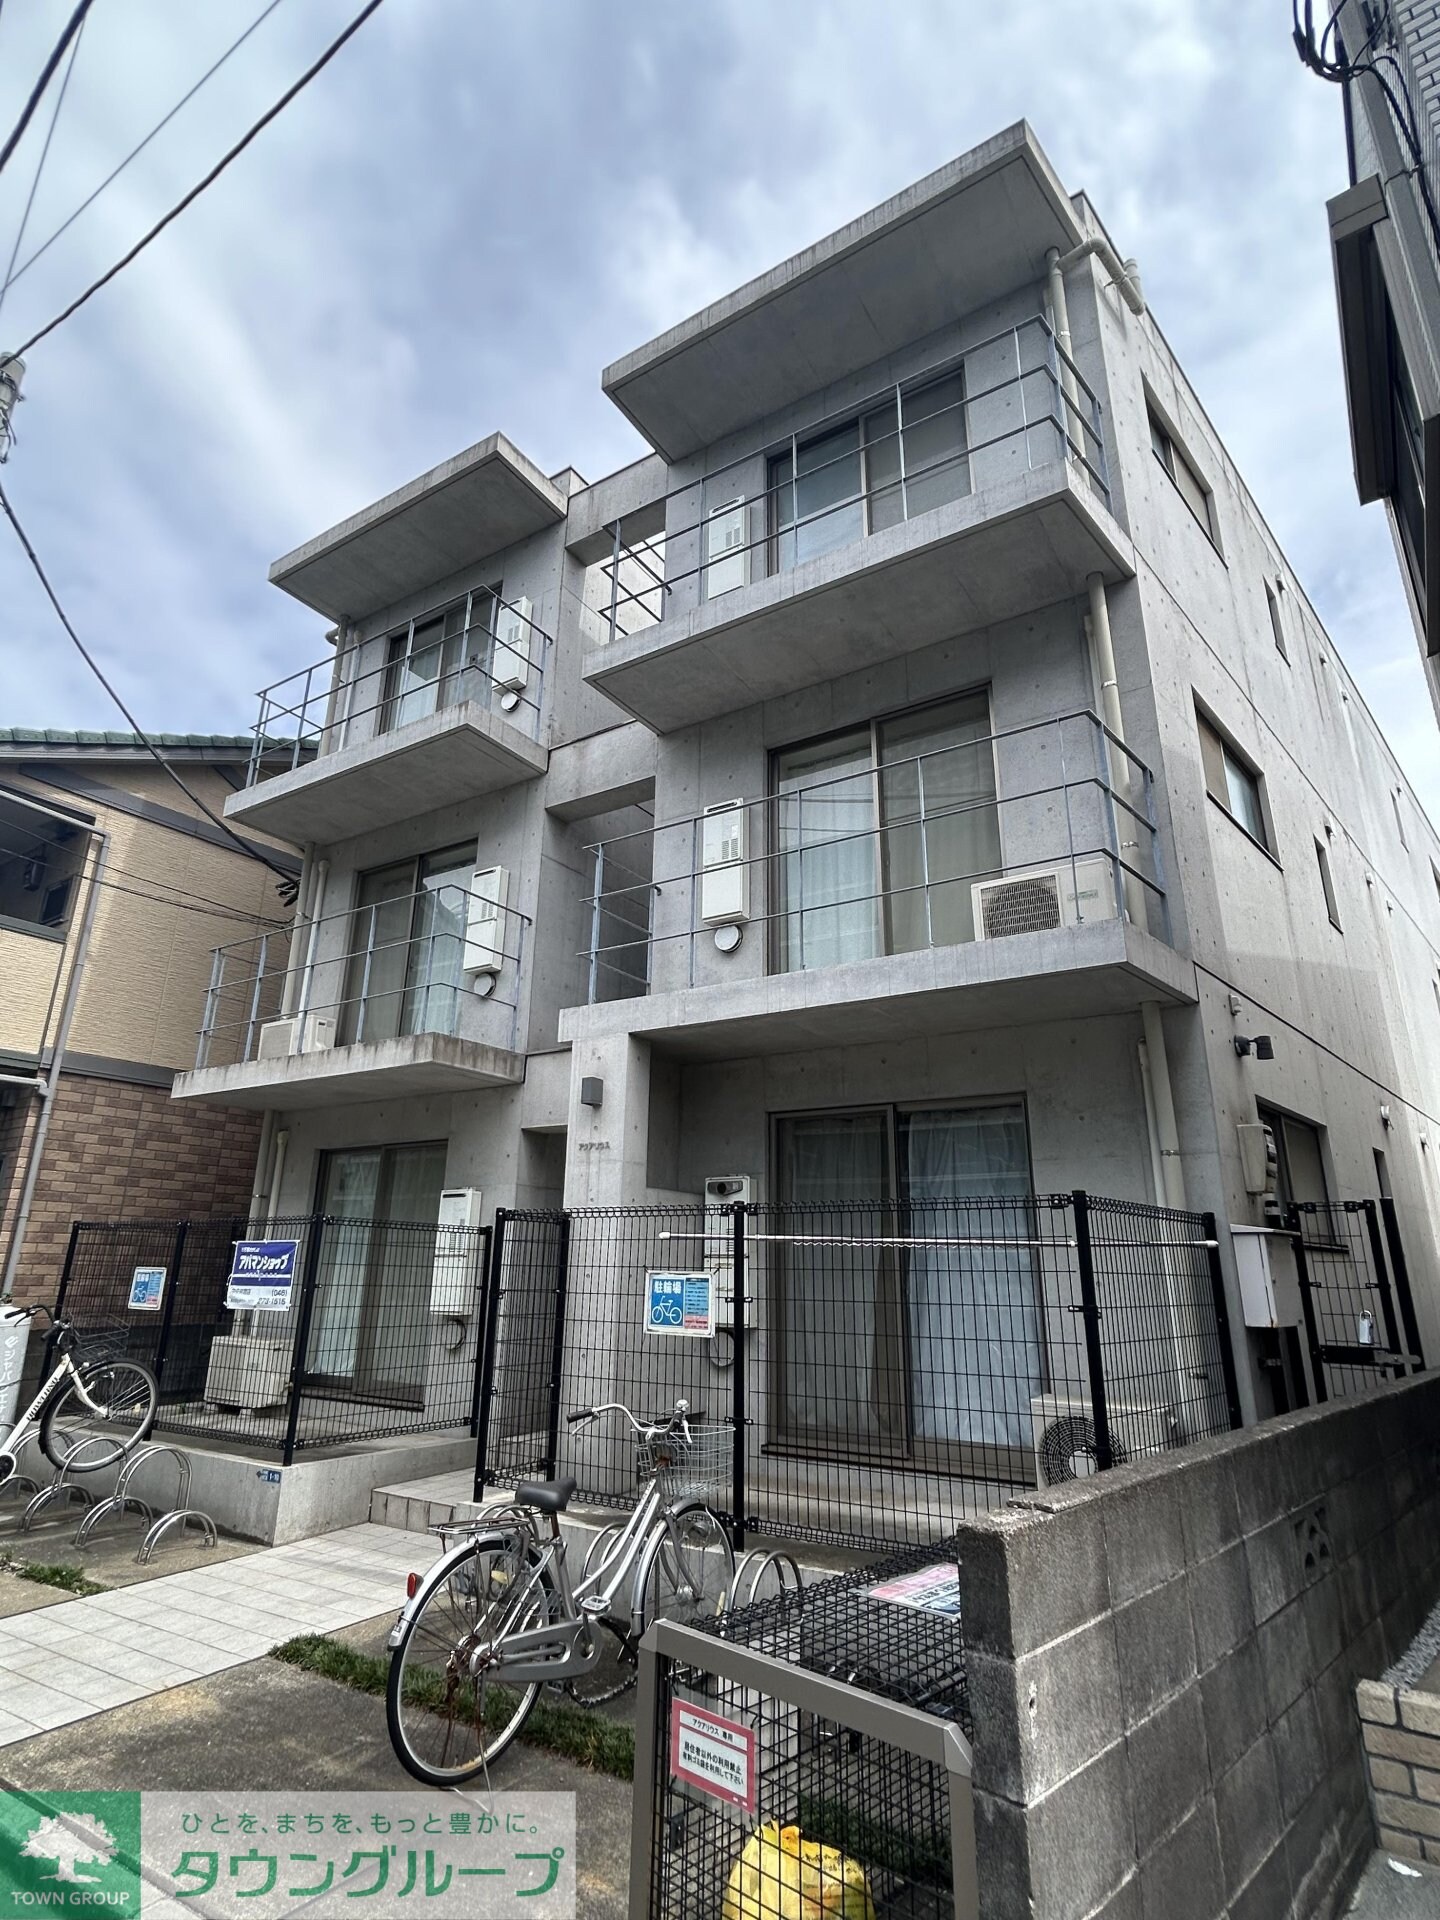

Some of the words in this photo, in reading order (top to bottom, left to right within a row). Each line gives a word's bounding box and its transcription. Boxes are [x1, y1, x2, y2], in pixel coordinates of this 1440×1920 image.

[238, 1253, 290, 1270] アパマンショップ
[653, 1280, 682, 1295] 駐輪場
[692, 1718, 720, 1736] アクアリウス
[722, 1731, 734, 1742] 専用
[684, 1741, 742, 1775] 居住者以外の利用禁止
